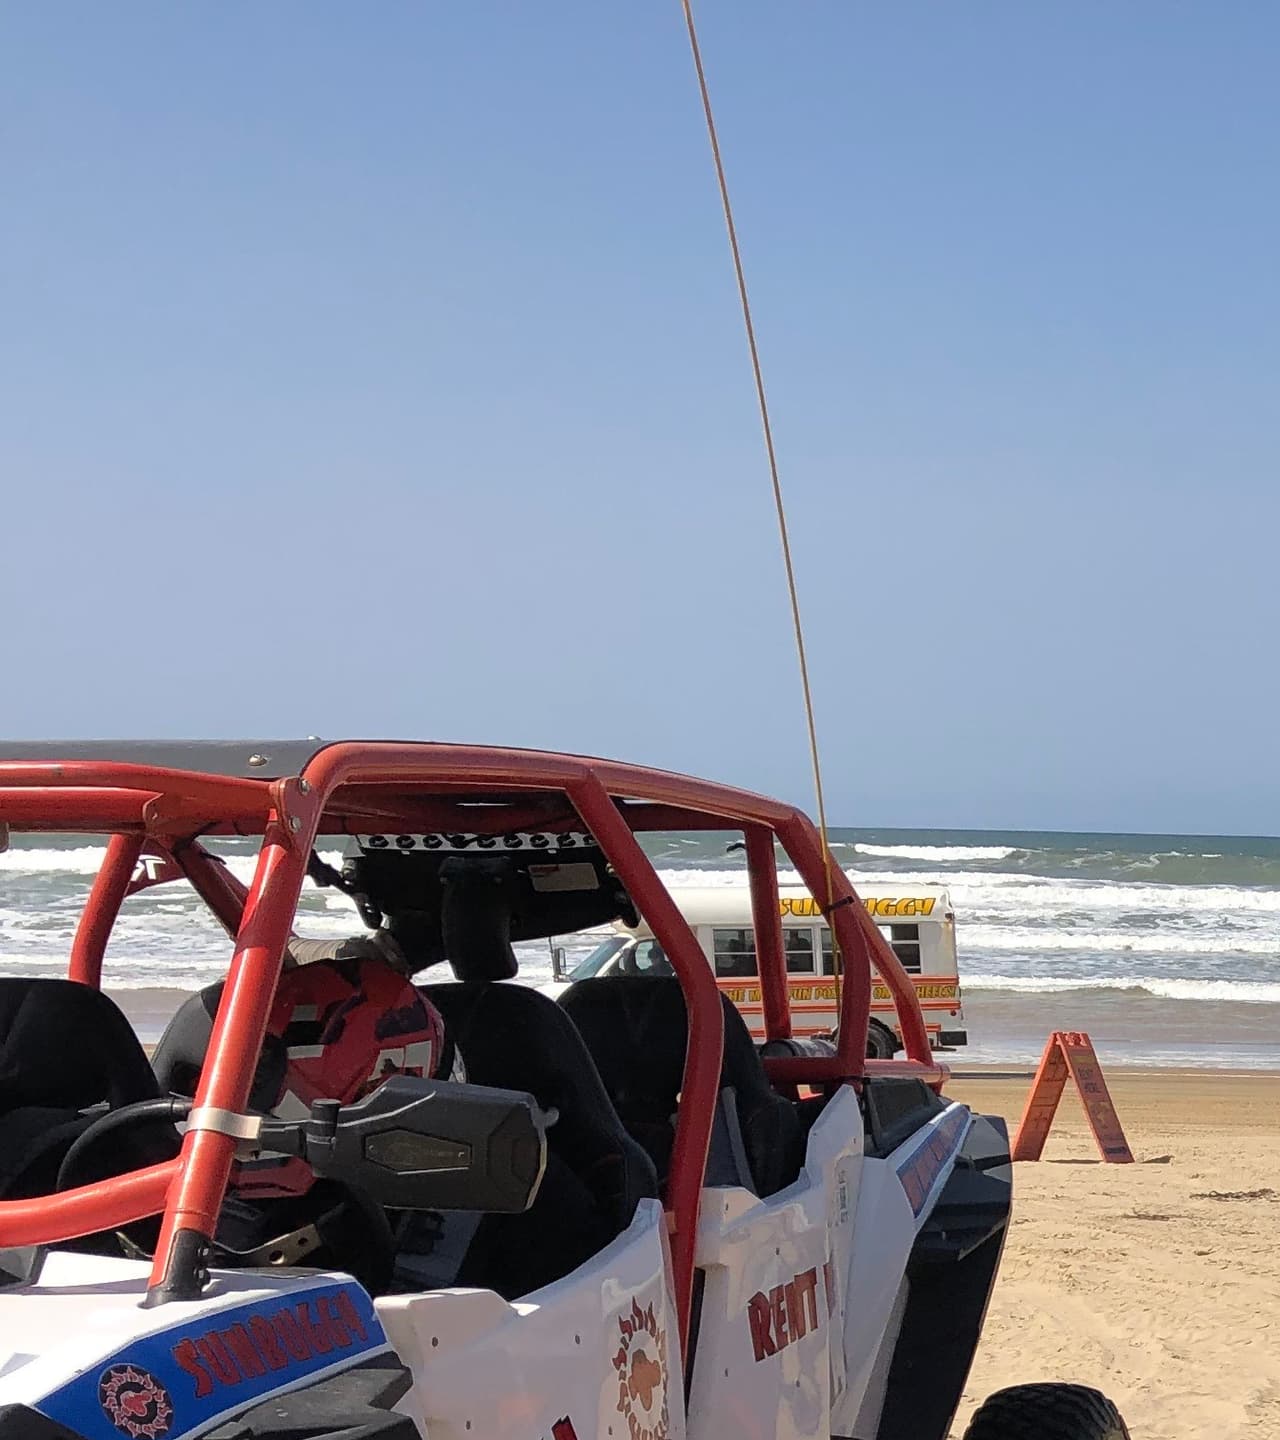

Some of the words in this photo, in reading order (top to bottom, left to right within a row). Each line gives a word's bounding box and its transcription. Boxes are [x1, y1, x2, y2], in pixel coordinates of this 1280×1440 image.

[780, 897, 936, 917] SUGGY
[171, 1290, 369, 1399] SUNBUGGY
[746, 1265, 818, 1363] RENT
